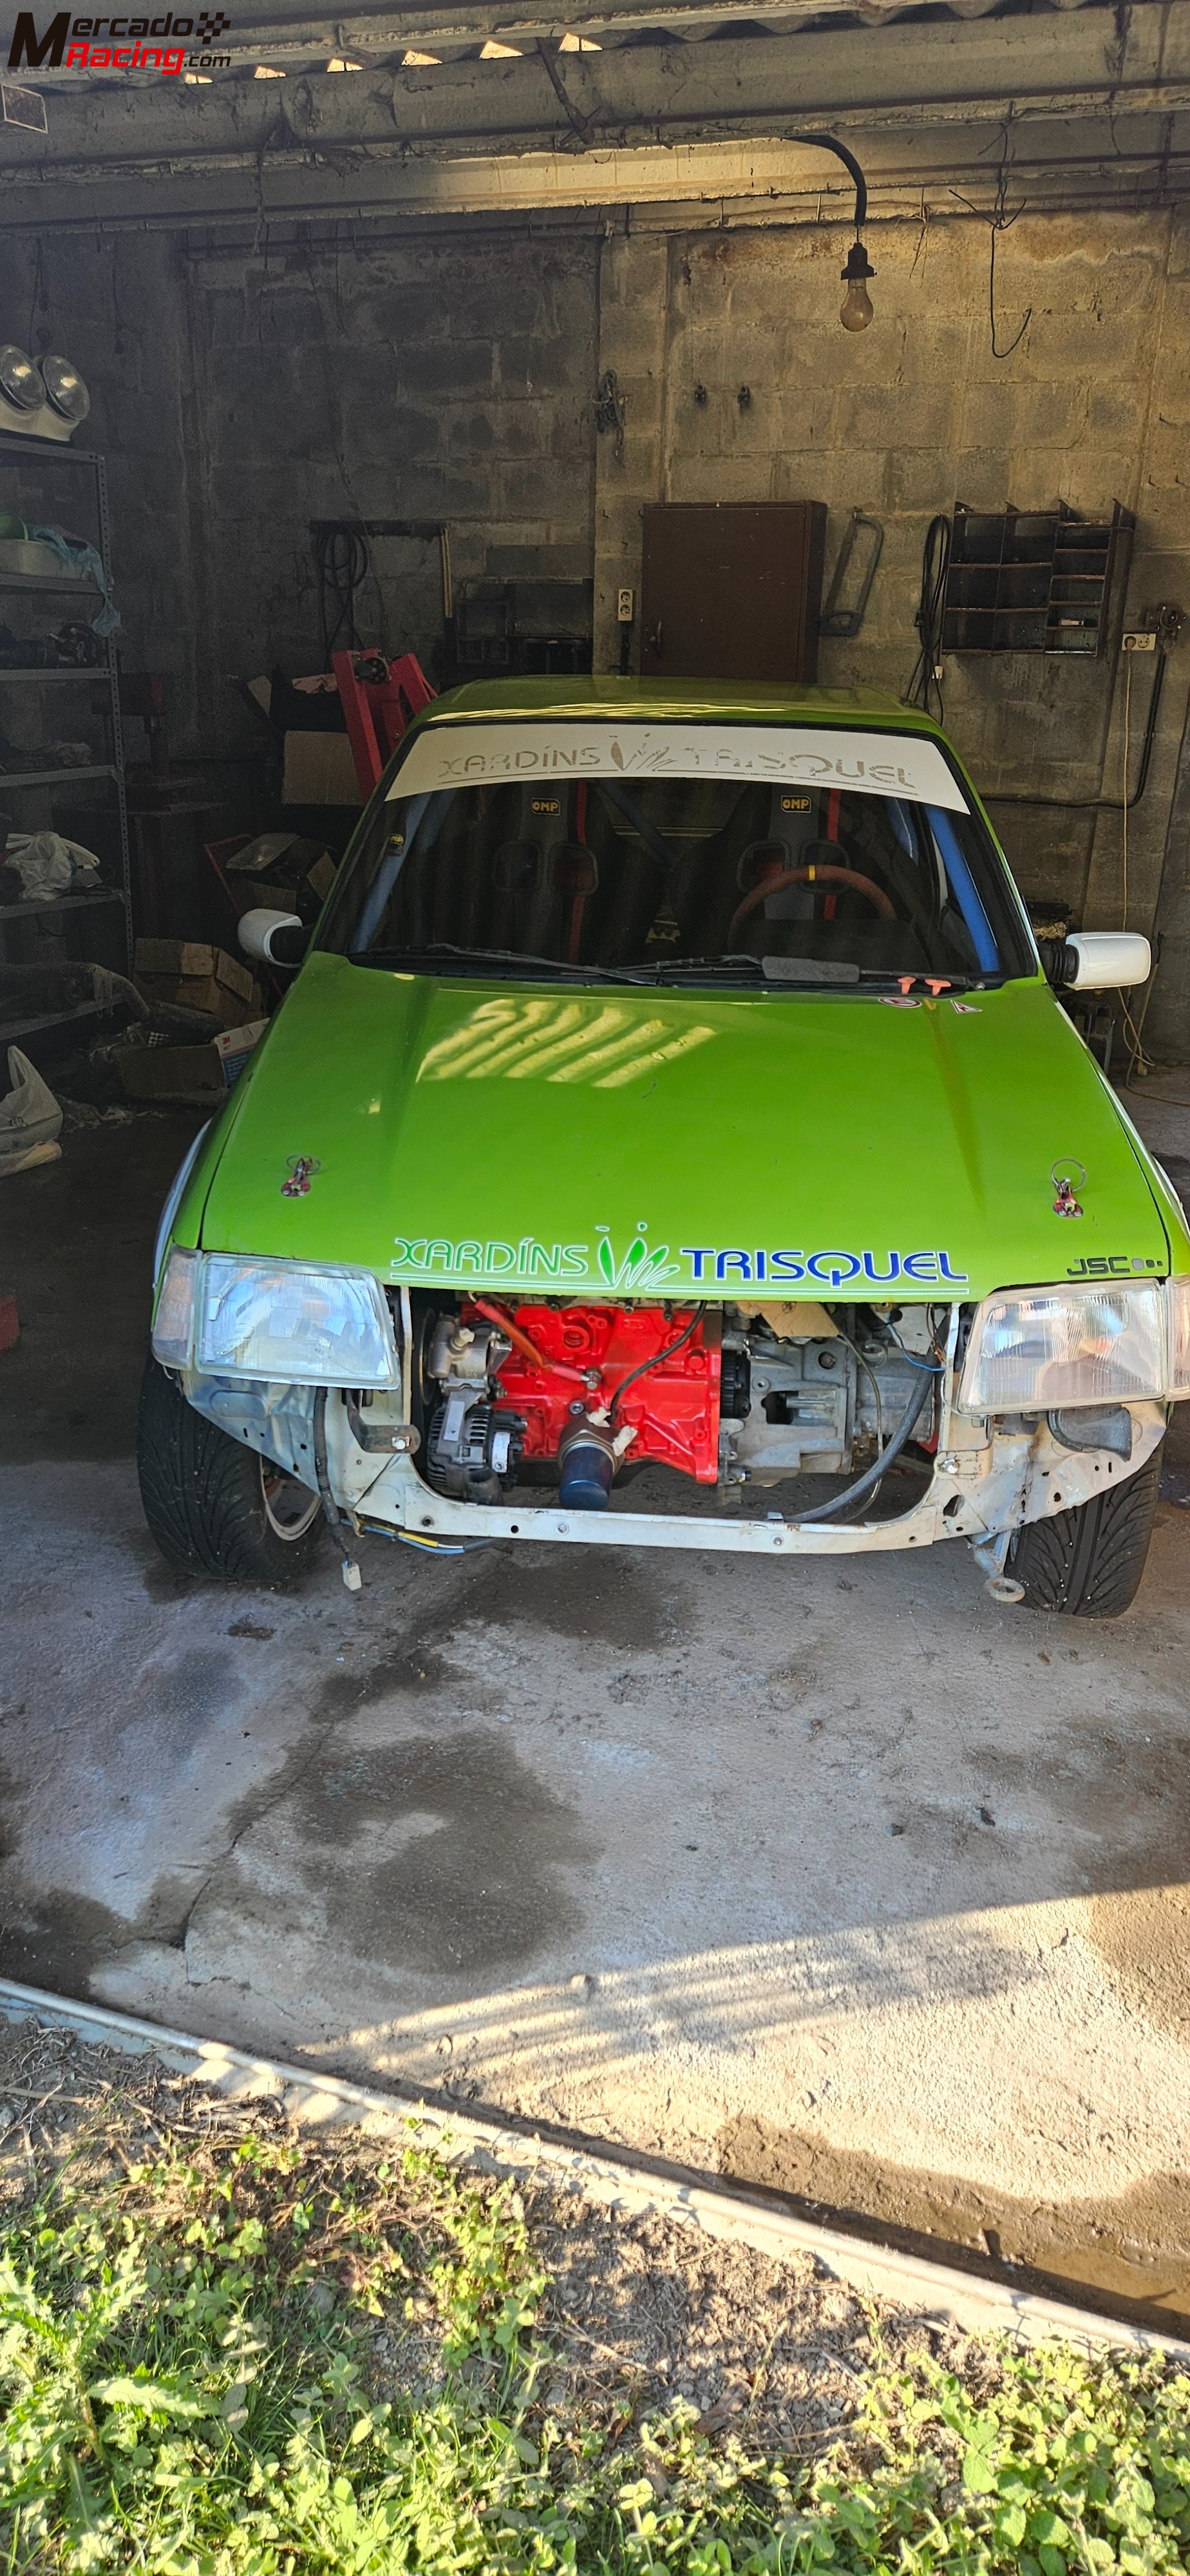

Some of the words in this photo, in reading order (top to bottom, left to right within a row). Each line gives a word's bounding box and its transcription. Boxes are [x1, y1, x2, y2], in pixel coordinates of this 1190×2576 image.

[533, 801, 558, 812] OMP
[782, 799, 809, 810] OMP
[222, 1036, 231, 1045] 3M
[392, 1238, 588, 1276] XARDÍNS
[680, 1248, 968, 1287] TRISQUEL
[1066, 1256, 1131, 1276] JSC
